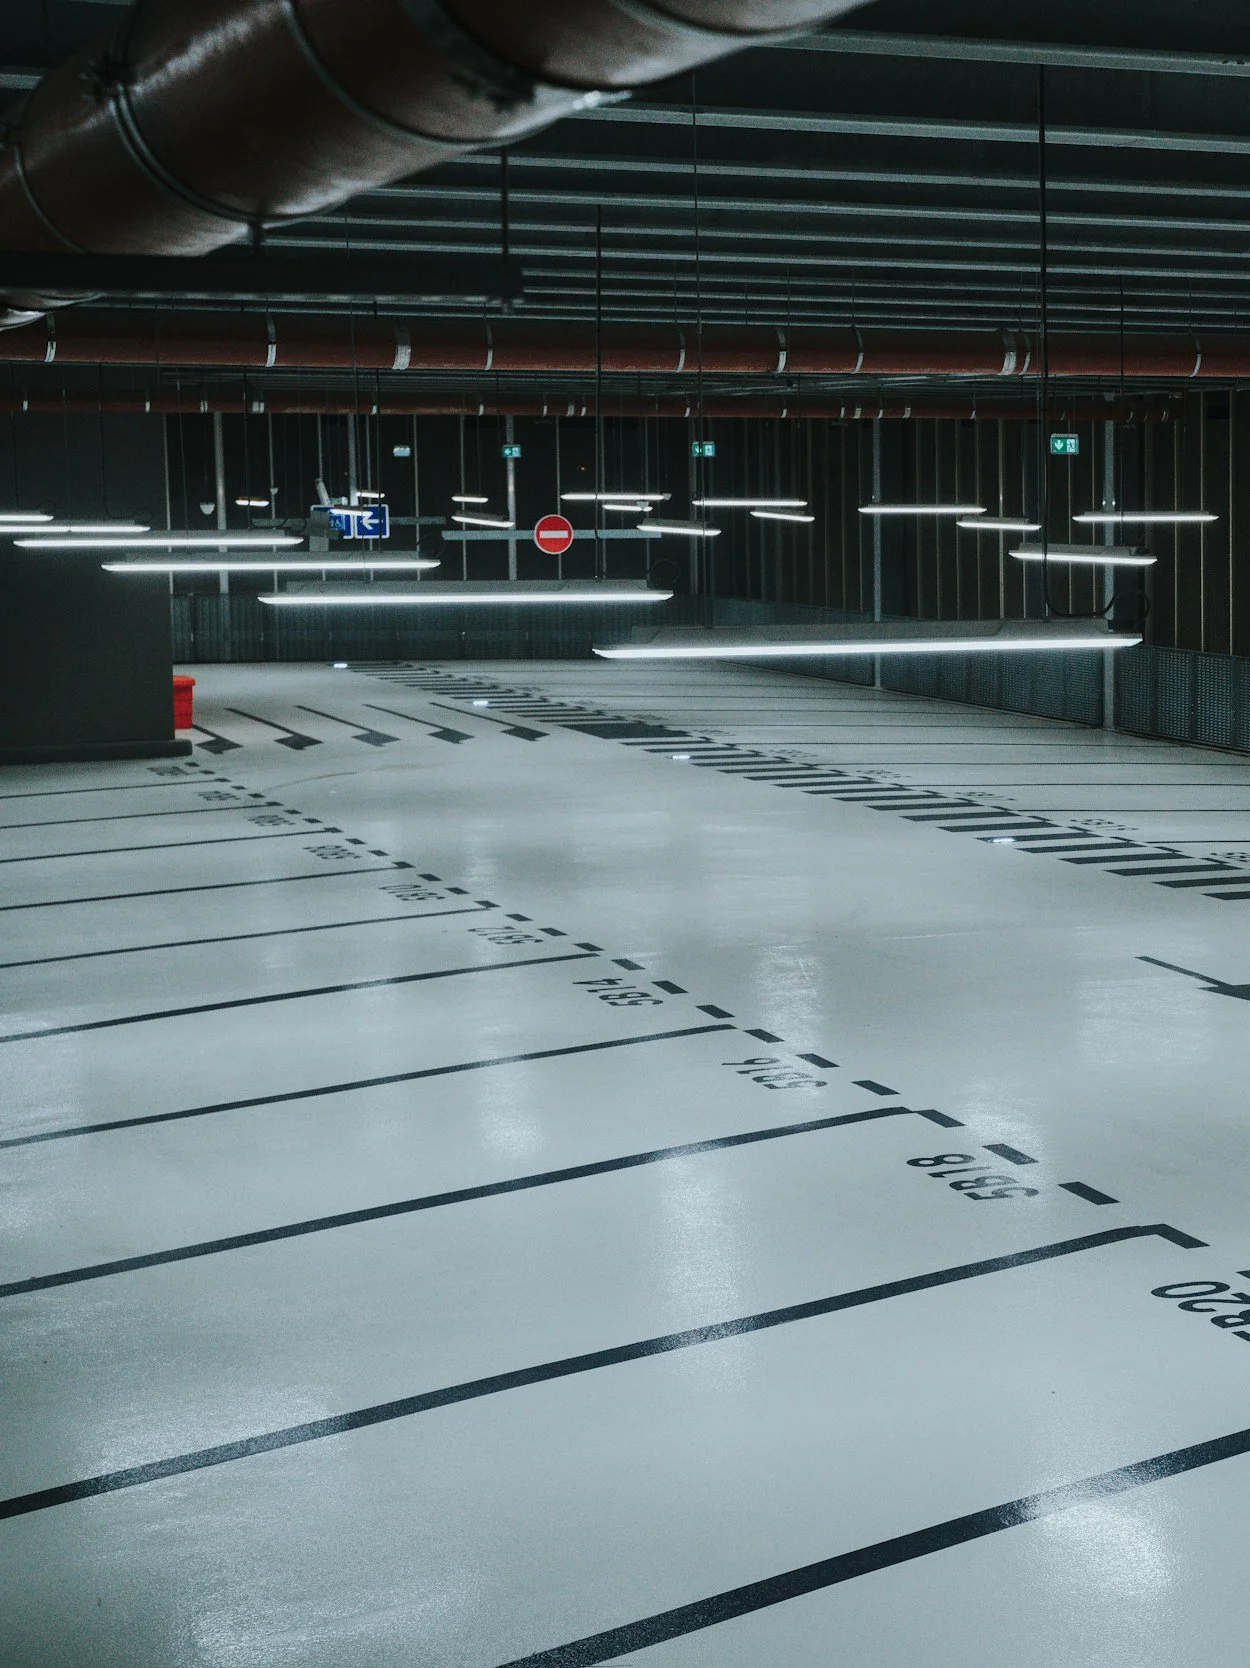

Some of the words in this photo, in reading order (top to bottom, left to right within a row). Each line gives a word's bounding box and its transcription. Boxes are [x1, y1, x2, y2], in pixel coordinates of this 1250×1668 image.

[378, 884, 446, 902] 5B10
[467, 926, 543, 945] 5B12
[571, 978, 663, 1007] 5B14
[722, 1057, 828, 1090] 5B16
[907, 1153, 1040, 1200] 5B18
